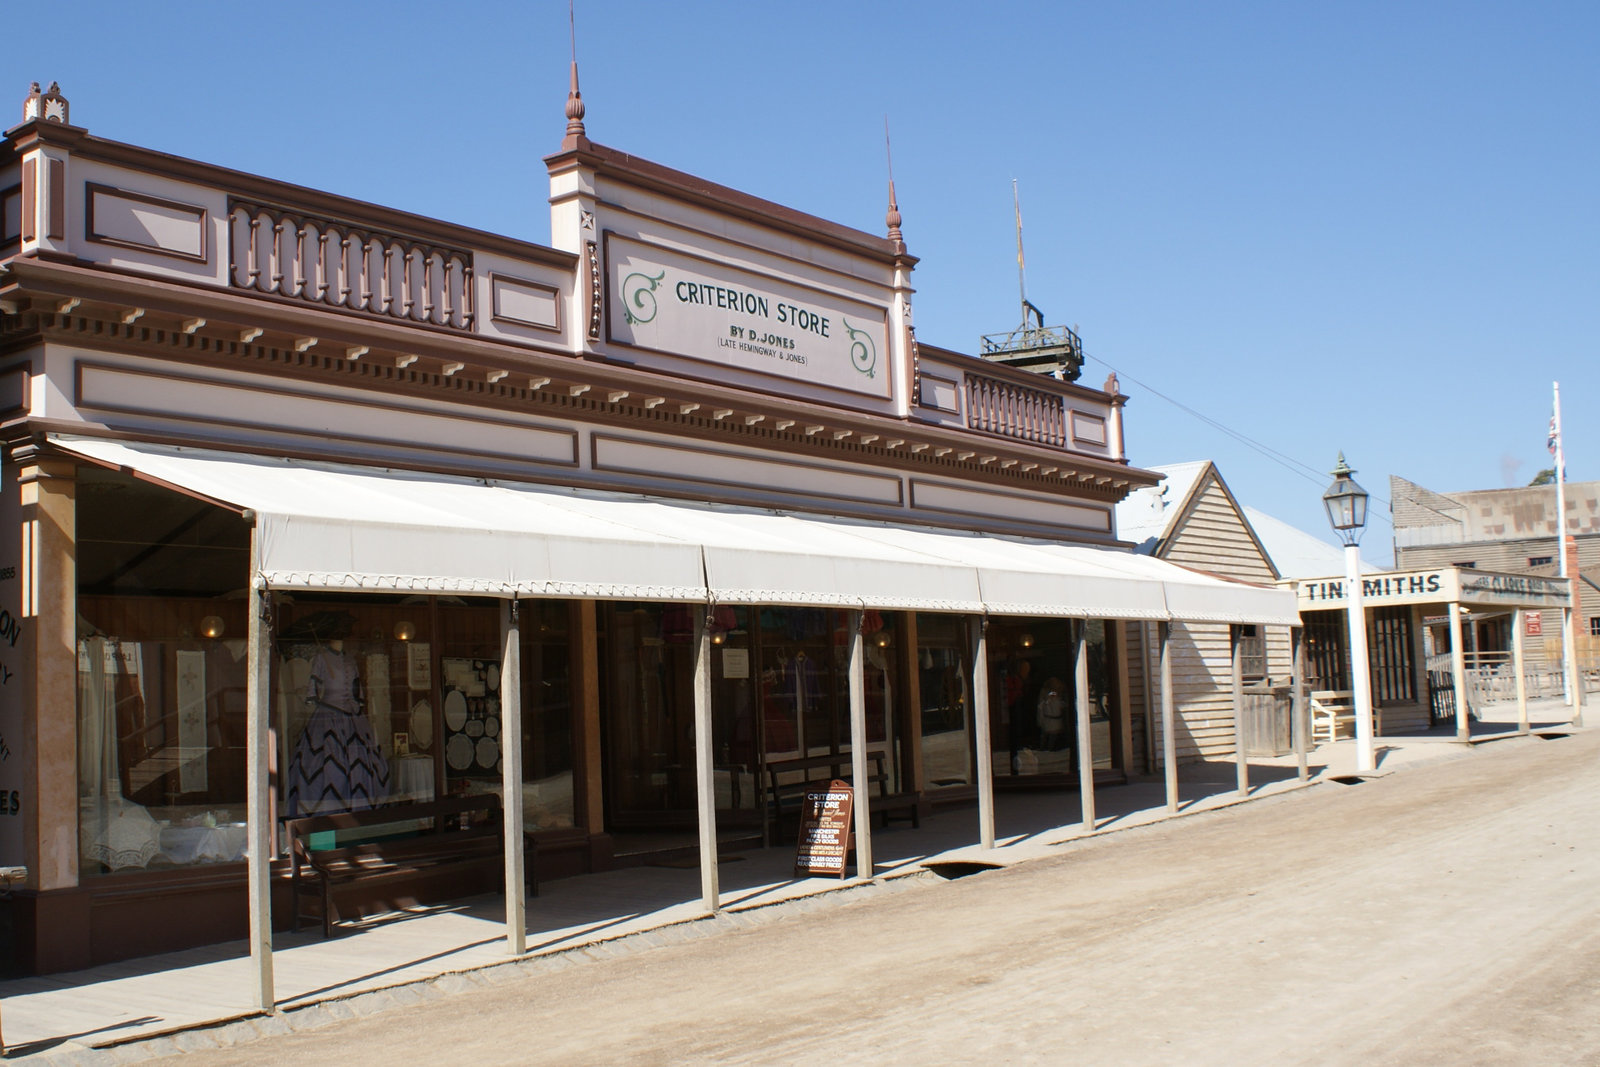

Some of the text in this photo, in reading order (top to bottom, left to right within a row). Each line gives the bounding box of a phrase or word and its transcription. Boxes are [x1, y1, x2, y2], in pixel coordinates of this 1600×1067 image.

[676, 281, 830, 338] CRITERION STORE
[730, 325, 745, 338] BY
[717, 335, 808, 367] (LATE HEMINGWAY & JONES)
[1305, 574, 1441, 600] TINMITHS
[807, 793, 849, 801] CRITERION
[814, 801, 841, 809] STORE
